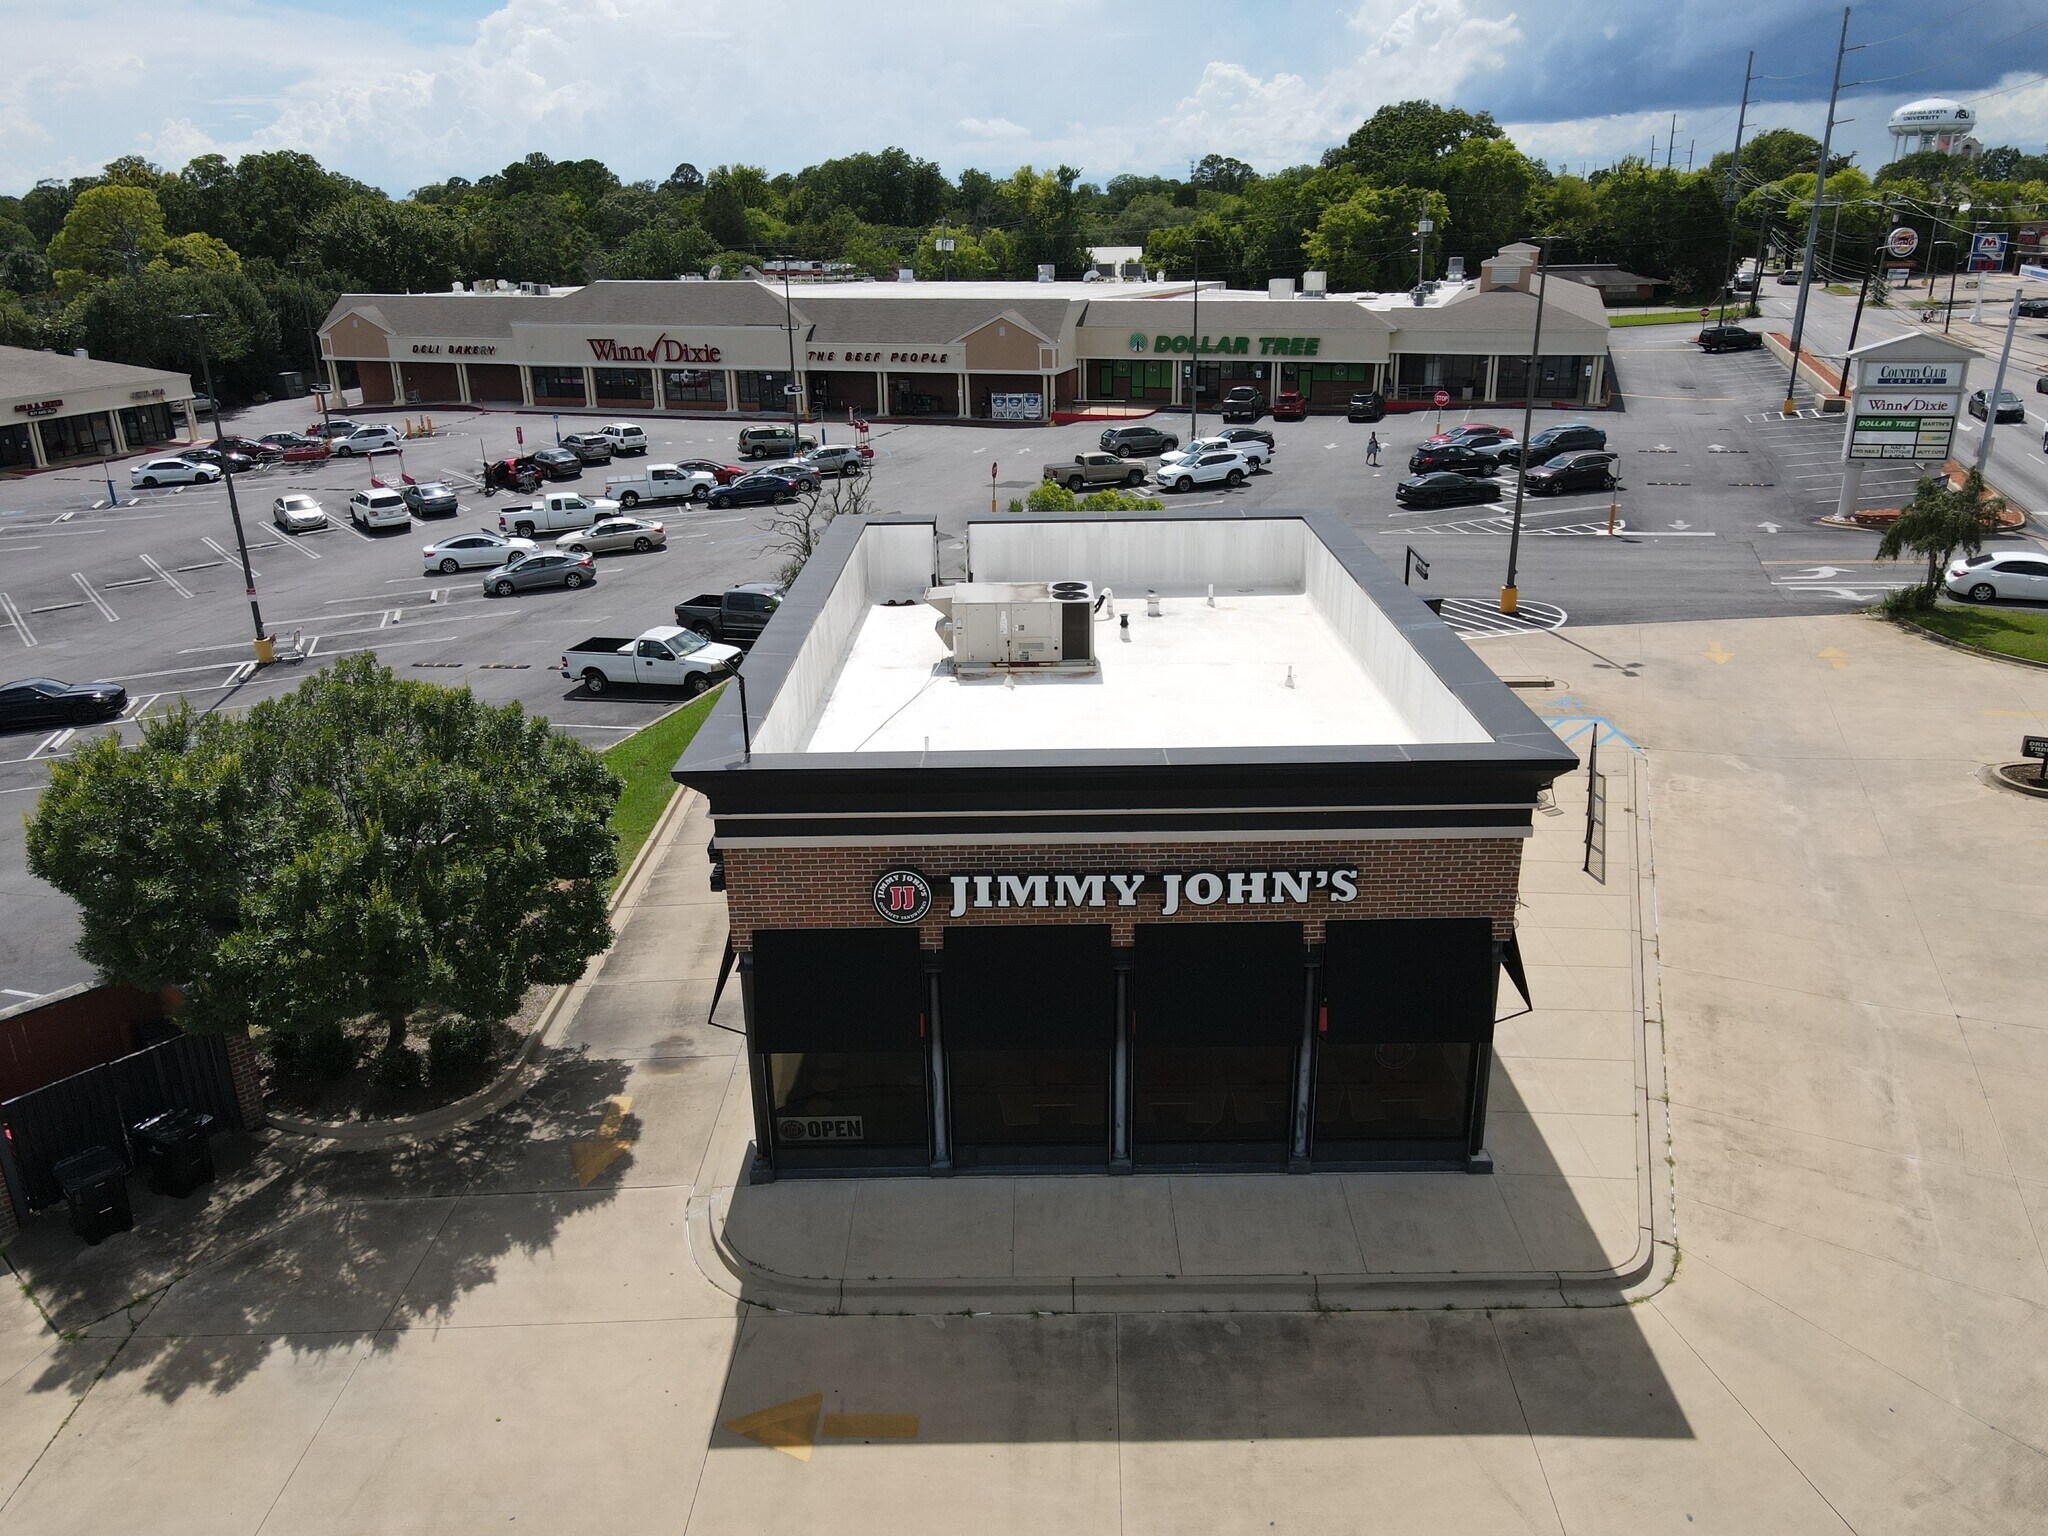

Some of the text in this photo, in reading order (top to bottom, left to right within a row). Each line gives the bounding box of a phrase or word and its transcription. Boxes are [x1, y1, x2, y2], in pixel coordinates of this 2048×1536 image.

[412, 344, 496, 355] DELI BAKERY
[586, 338, 722, 363] Winn Dixie
[1154, 335, 1321, 356] DOLLAR TREE
[808, 351, 948, 363] THE BEEF PEOPLE
[1880, 365, 1947, 378] COUNTRY CLUB
[1868, 399, 1948, 411] Winn Dixie
[878, 874, 927, 898] JIMMY JOHN'S
[949, 869, 1359, 917] JIMMY JOHN'S
[890, 886, 915, 910] JJ
[807, 1120, 862, 1138] OPEN
